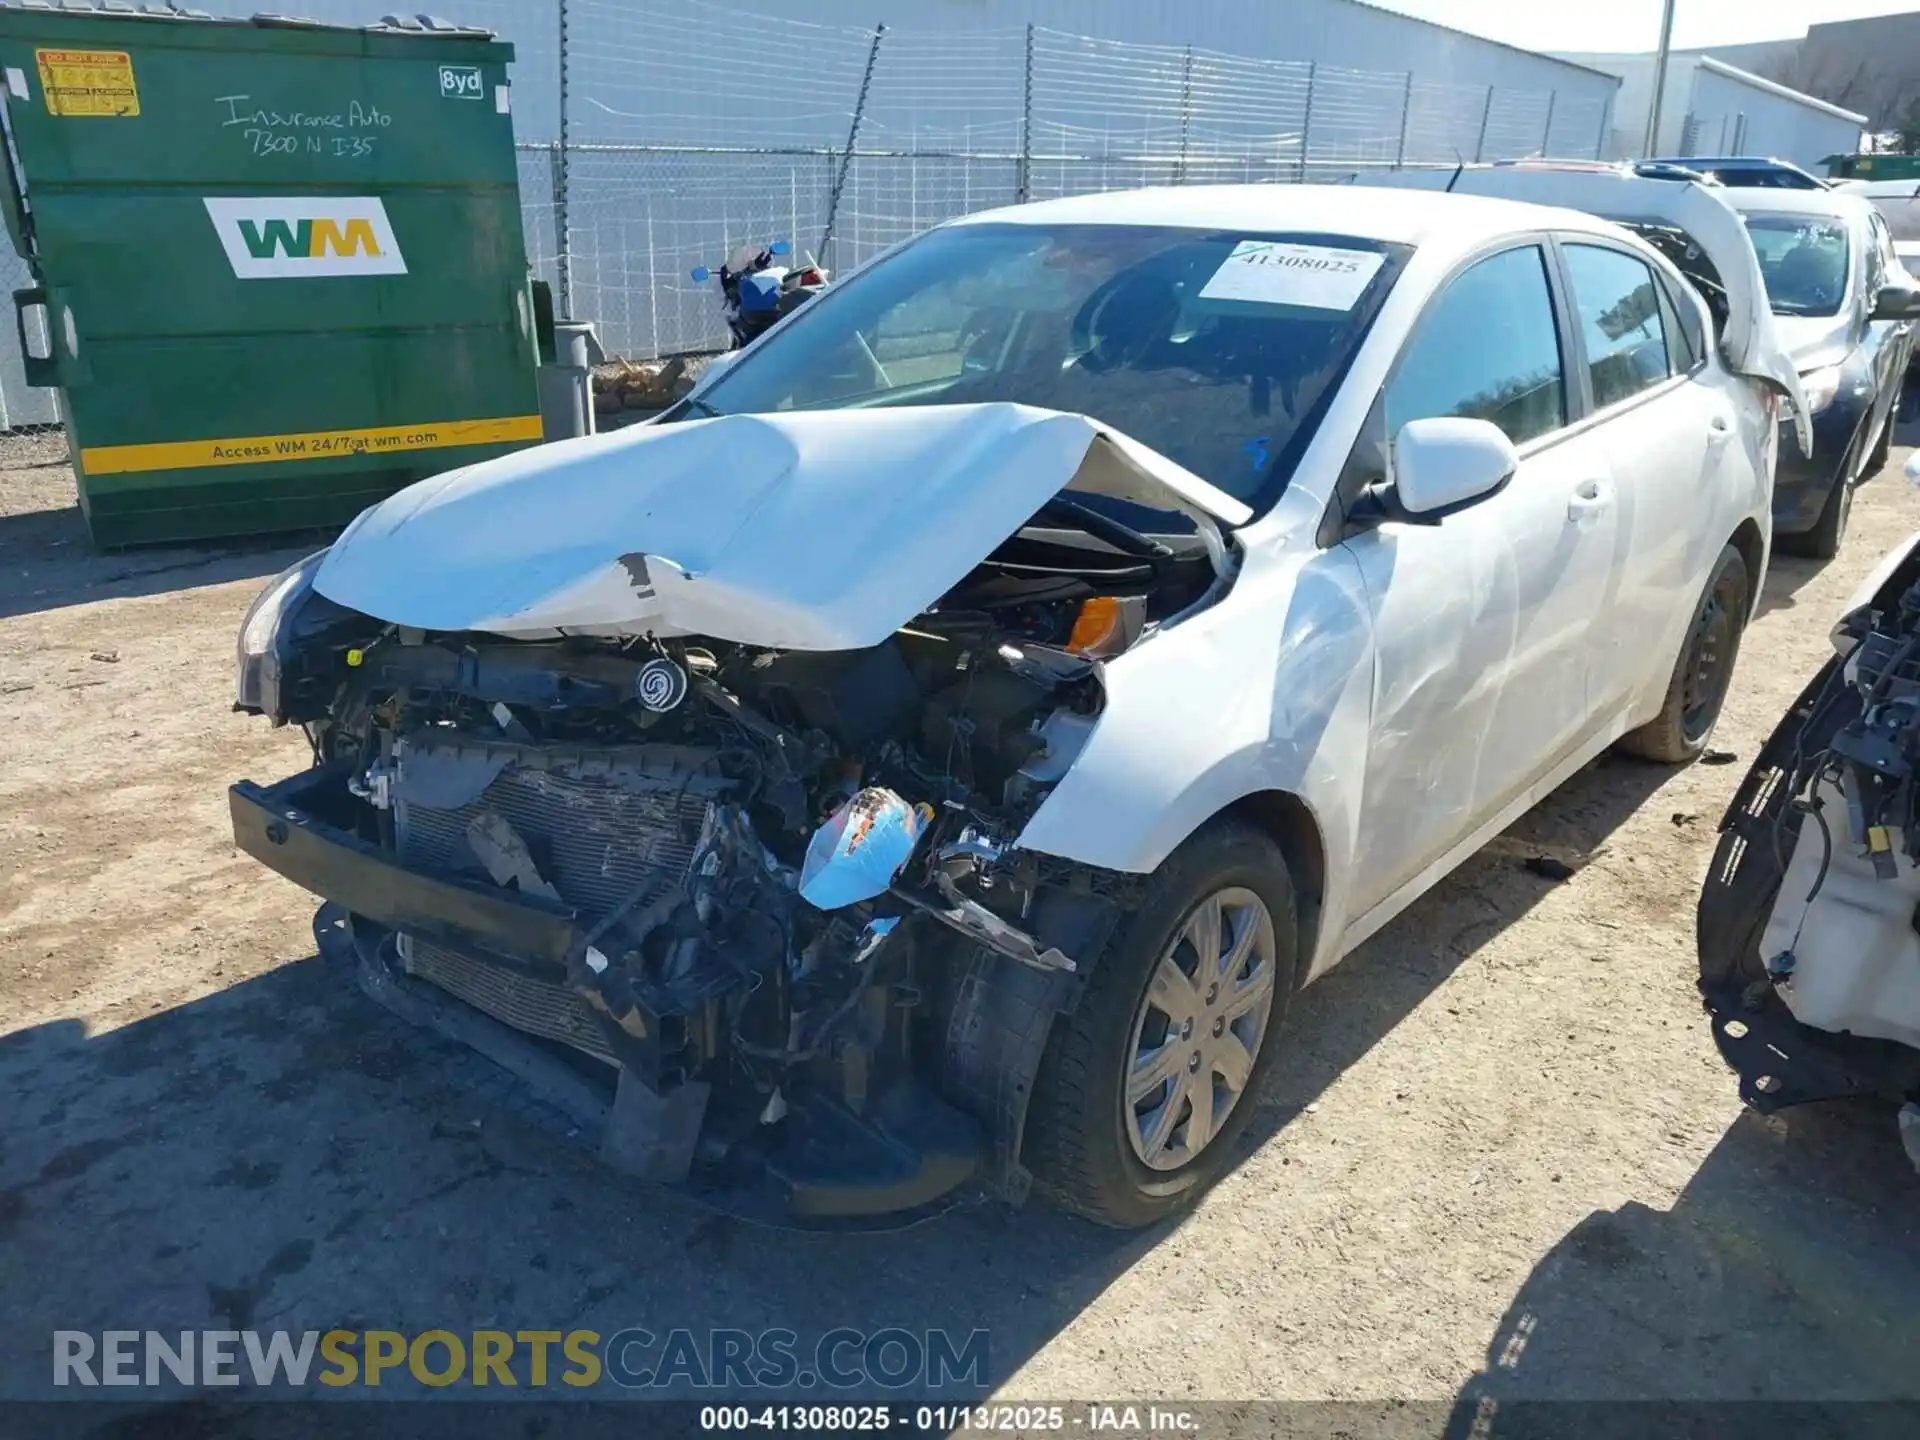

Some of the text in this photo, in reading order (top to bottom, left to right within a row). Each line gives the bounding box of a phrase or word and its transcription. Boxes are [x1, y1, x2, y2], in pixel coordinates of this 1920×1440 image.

[443, 70, 480, 94] 8yd
[214, 95, 391, 128] Insurance Auto
[244, 129, 298, 157] 7300
[306, 136, 322, 153] N
[236, 218, 382, 258] WM
[1241, 253, 1361, 273] 41308025
[212, 445, 271, 460] Access
[275, 440, 306, 455] WM
[311, 437, 351, 453] 24/7
[374, 431, 438, 447] wm.com
